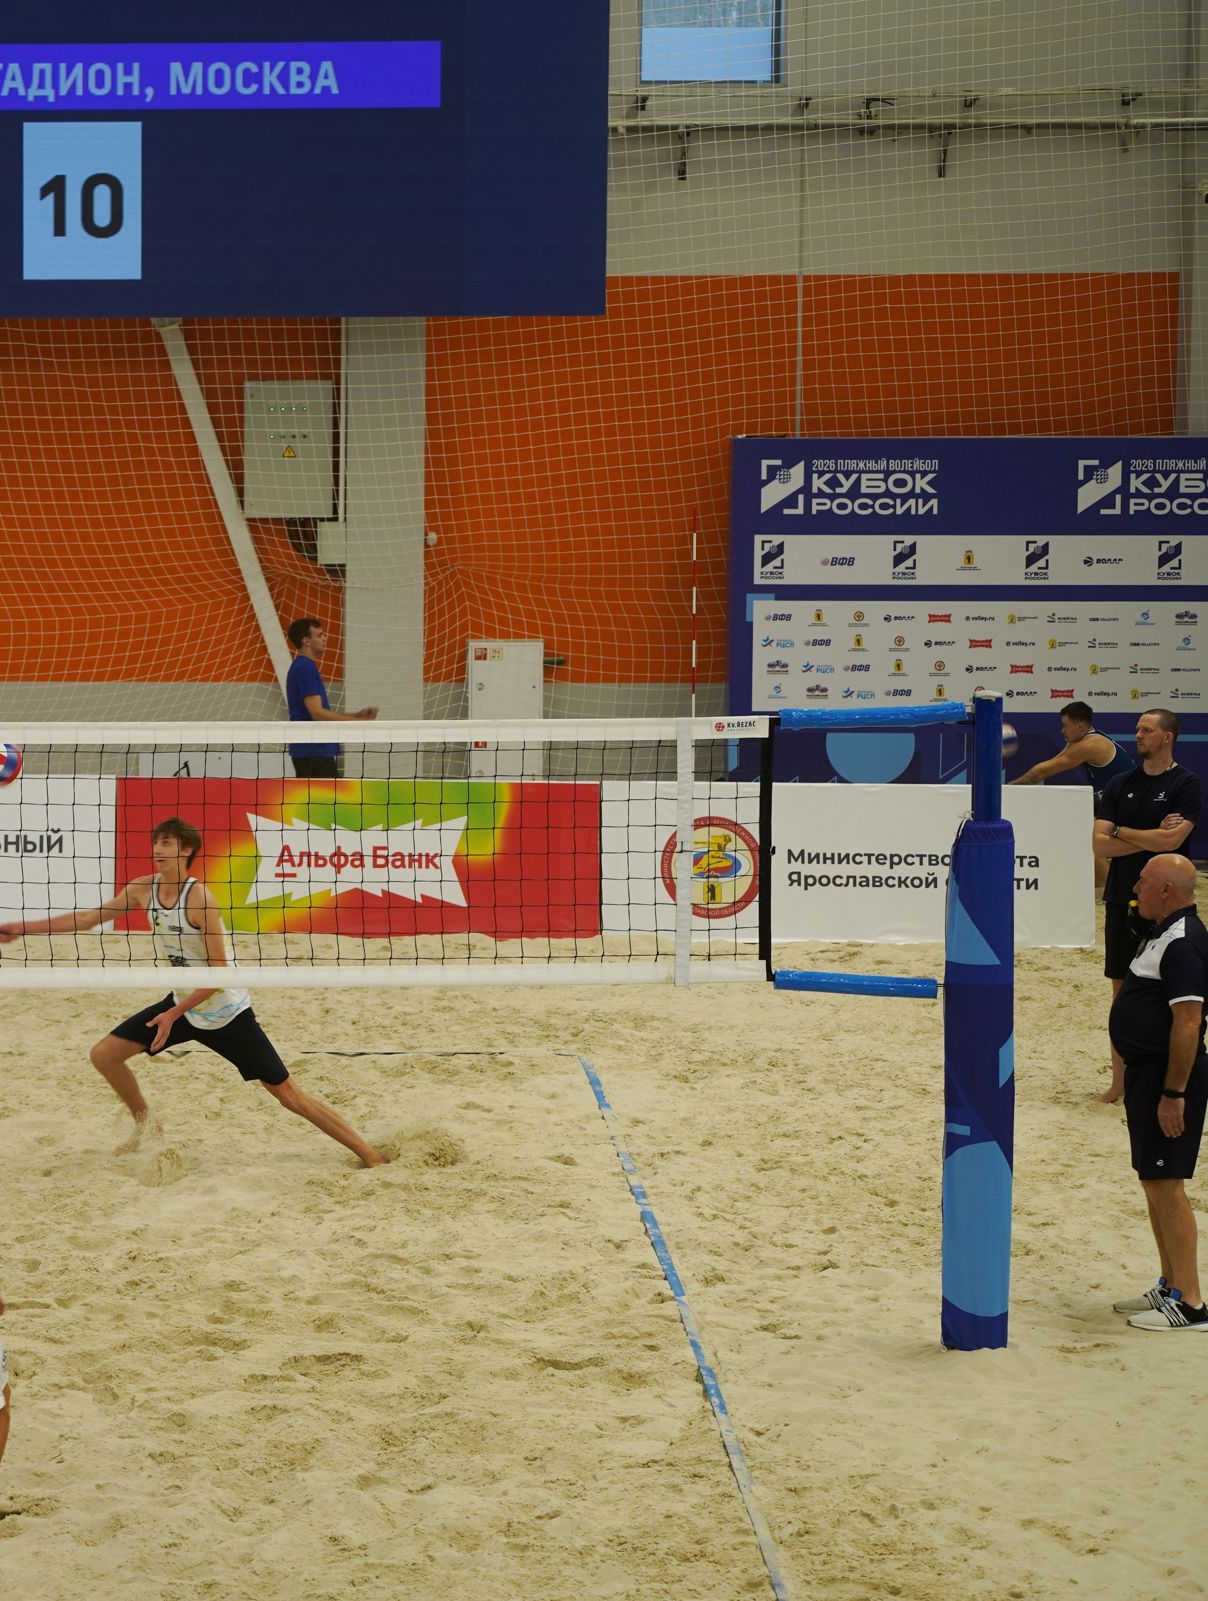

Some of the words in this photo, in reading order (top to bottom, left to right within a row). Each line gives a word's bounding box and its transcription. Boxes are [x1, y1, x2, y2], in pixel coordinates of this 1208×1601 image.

[168, 60, 340, 96] МОСКВА
[38, 173, 126, 239] 10
[812, 459, 836, 471] 2026
[838, 457, 886, 471] ПЛЯЖНЫЙ
[889, 457, 938, 471] ВОЛЕЙБОЛ
[1130, 459, 1154, 471] 2026
[1156, 457, 1206, 471] ПЛЯЖНЫЙ
[812, 473, 938, 493] КУБОК
[1130, 473, 1208, 493] КУБ
[812, 498, 938, 515] РОССИИ
[830, 557, 855, 566] ВФВ
[851, 664, 870, 672] ВФВ
[892, 689, 912, 697] ВФВ
[275, 844, 365, 875] Альфа
[372, 848, 440, 870] Банк
[787, 849, 951, 869] Министерство
[787, 871, 939, 891] Ярославской
